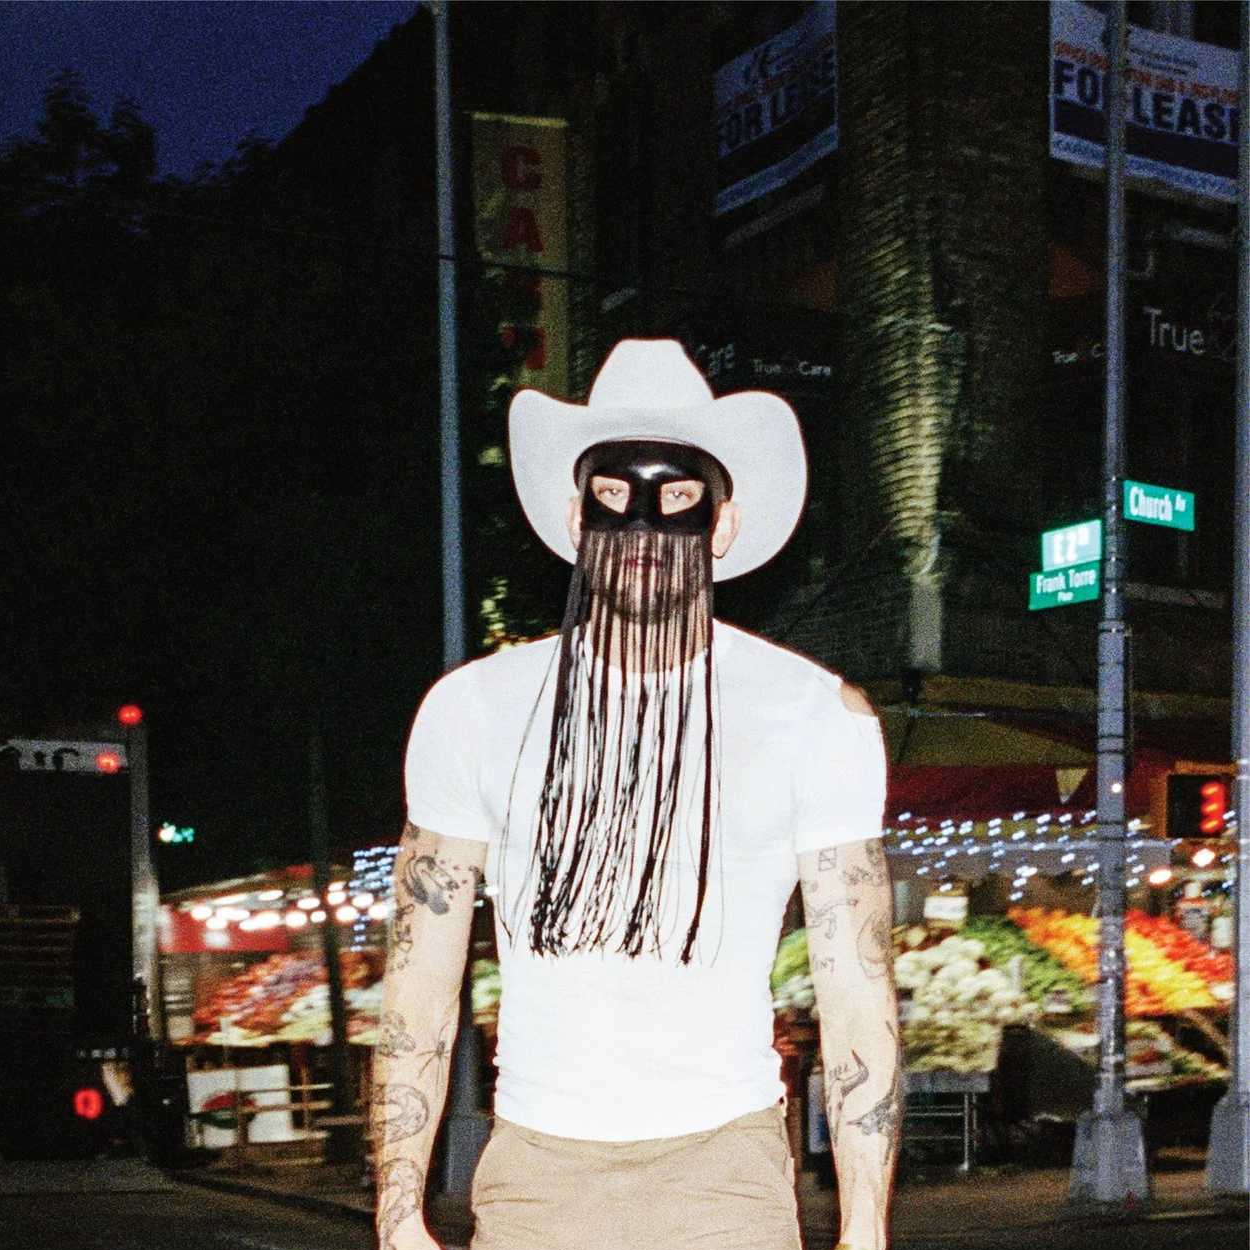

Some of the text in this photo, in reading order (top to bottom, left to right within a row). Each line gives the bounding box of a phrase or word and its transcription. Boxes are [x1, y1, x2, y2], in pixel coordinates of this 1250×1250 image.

[1053, 60, 1110, 113] FO
[1141, 305, 1207, 355] True
[1129, 485, 1173, 521] Church
[1036, 572, 1066, 594] Frank
